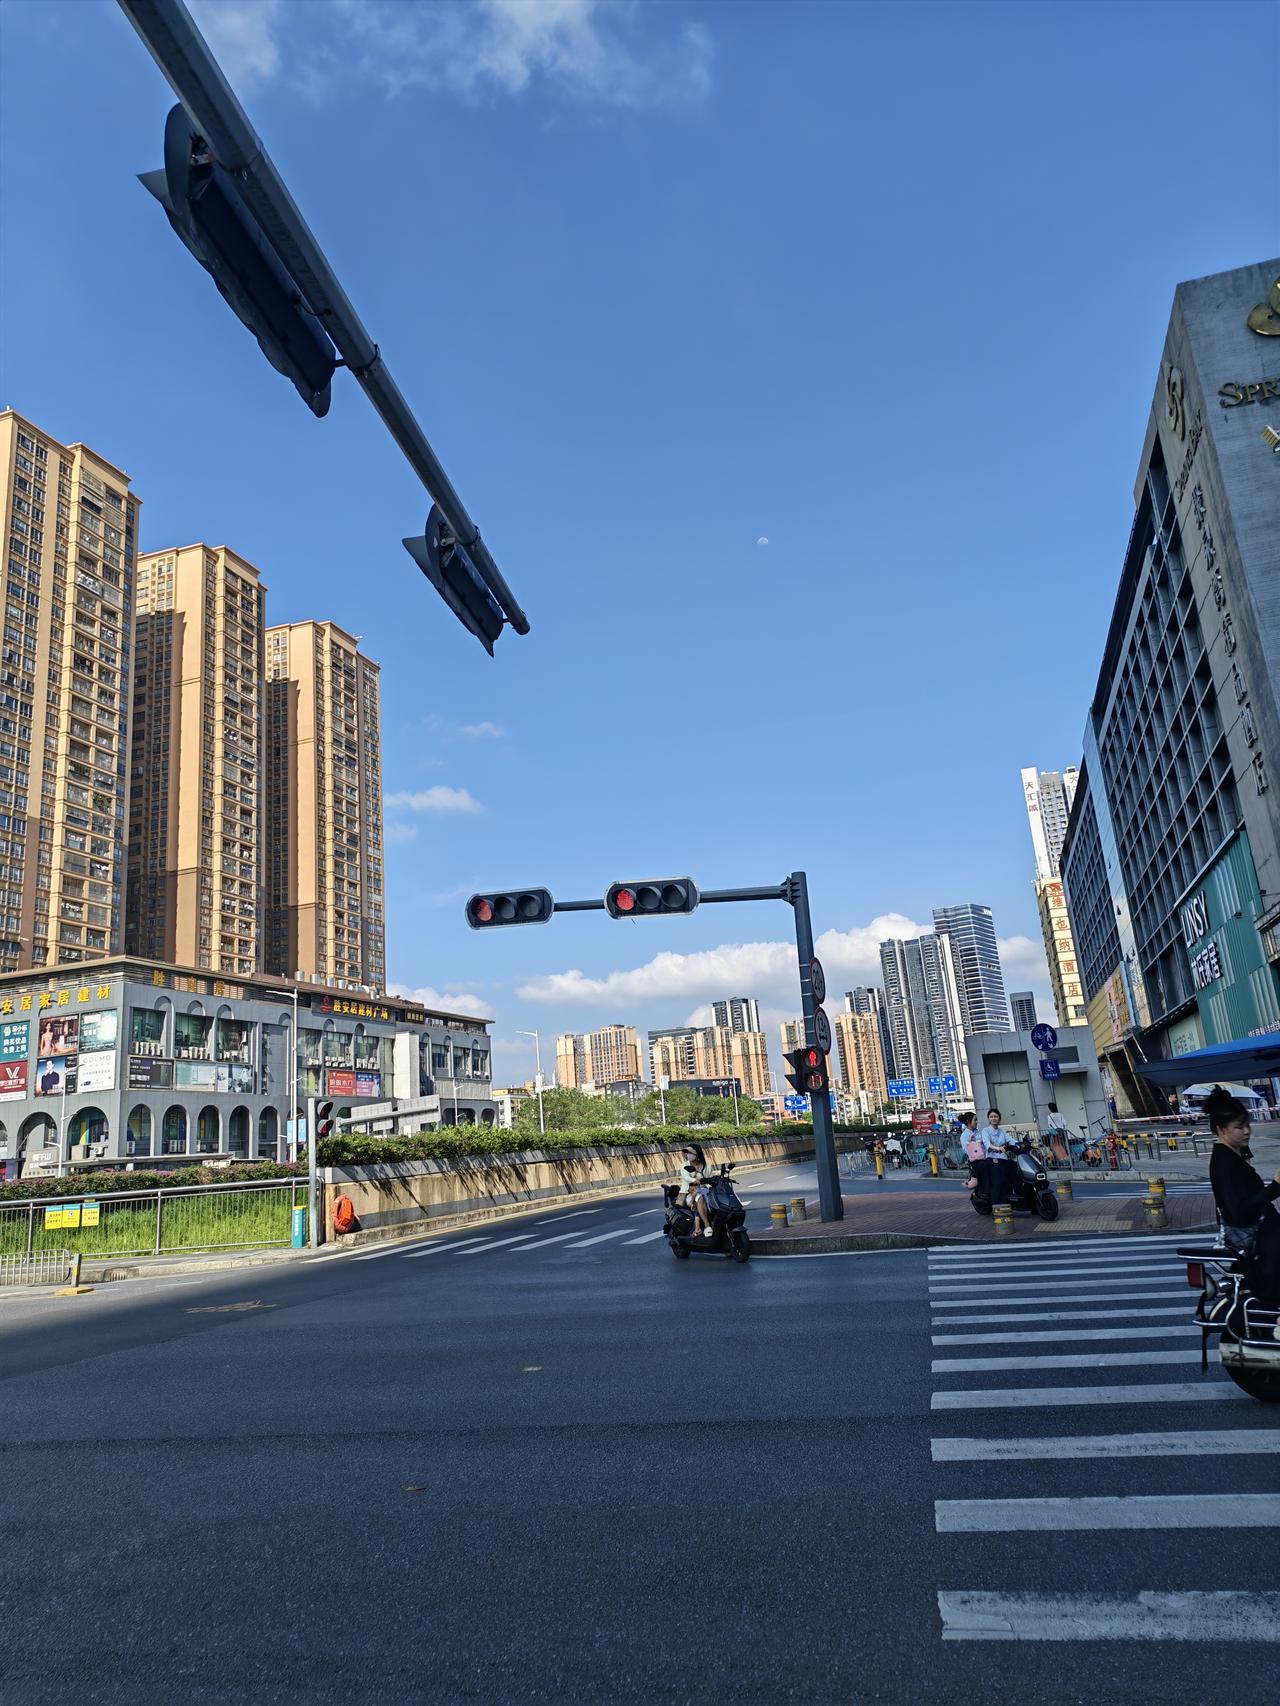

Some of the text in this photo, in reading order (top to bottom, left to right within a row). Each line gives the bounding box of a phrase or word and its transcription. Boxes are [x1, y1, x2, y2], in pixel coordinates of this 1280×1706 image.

[1181, 891, 1209, 949] LINSY
[1052, 897, 1080, 996] 维也纳酒店
[2, 985, 111, 1014] 安居家居建材
[3, 1045, 27, 1055] 免费上网
[82, 1054, 112, 1064] COLMO
